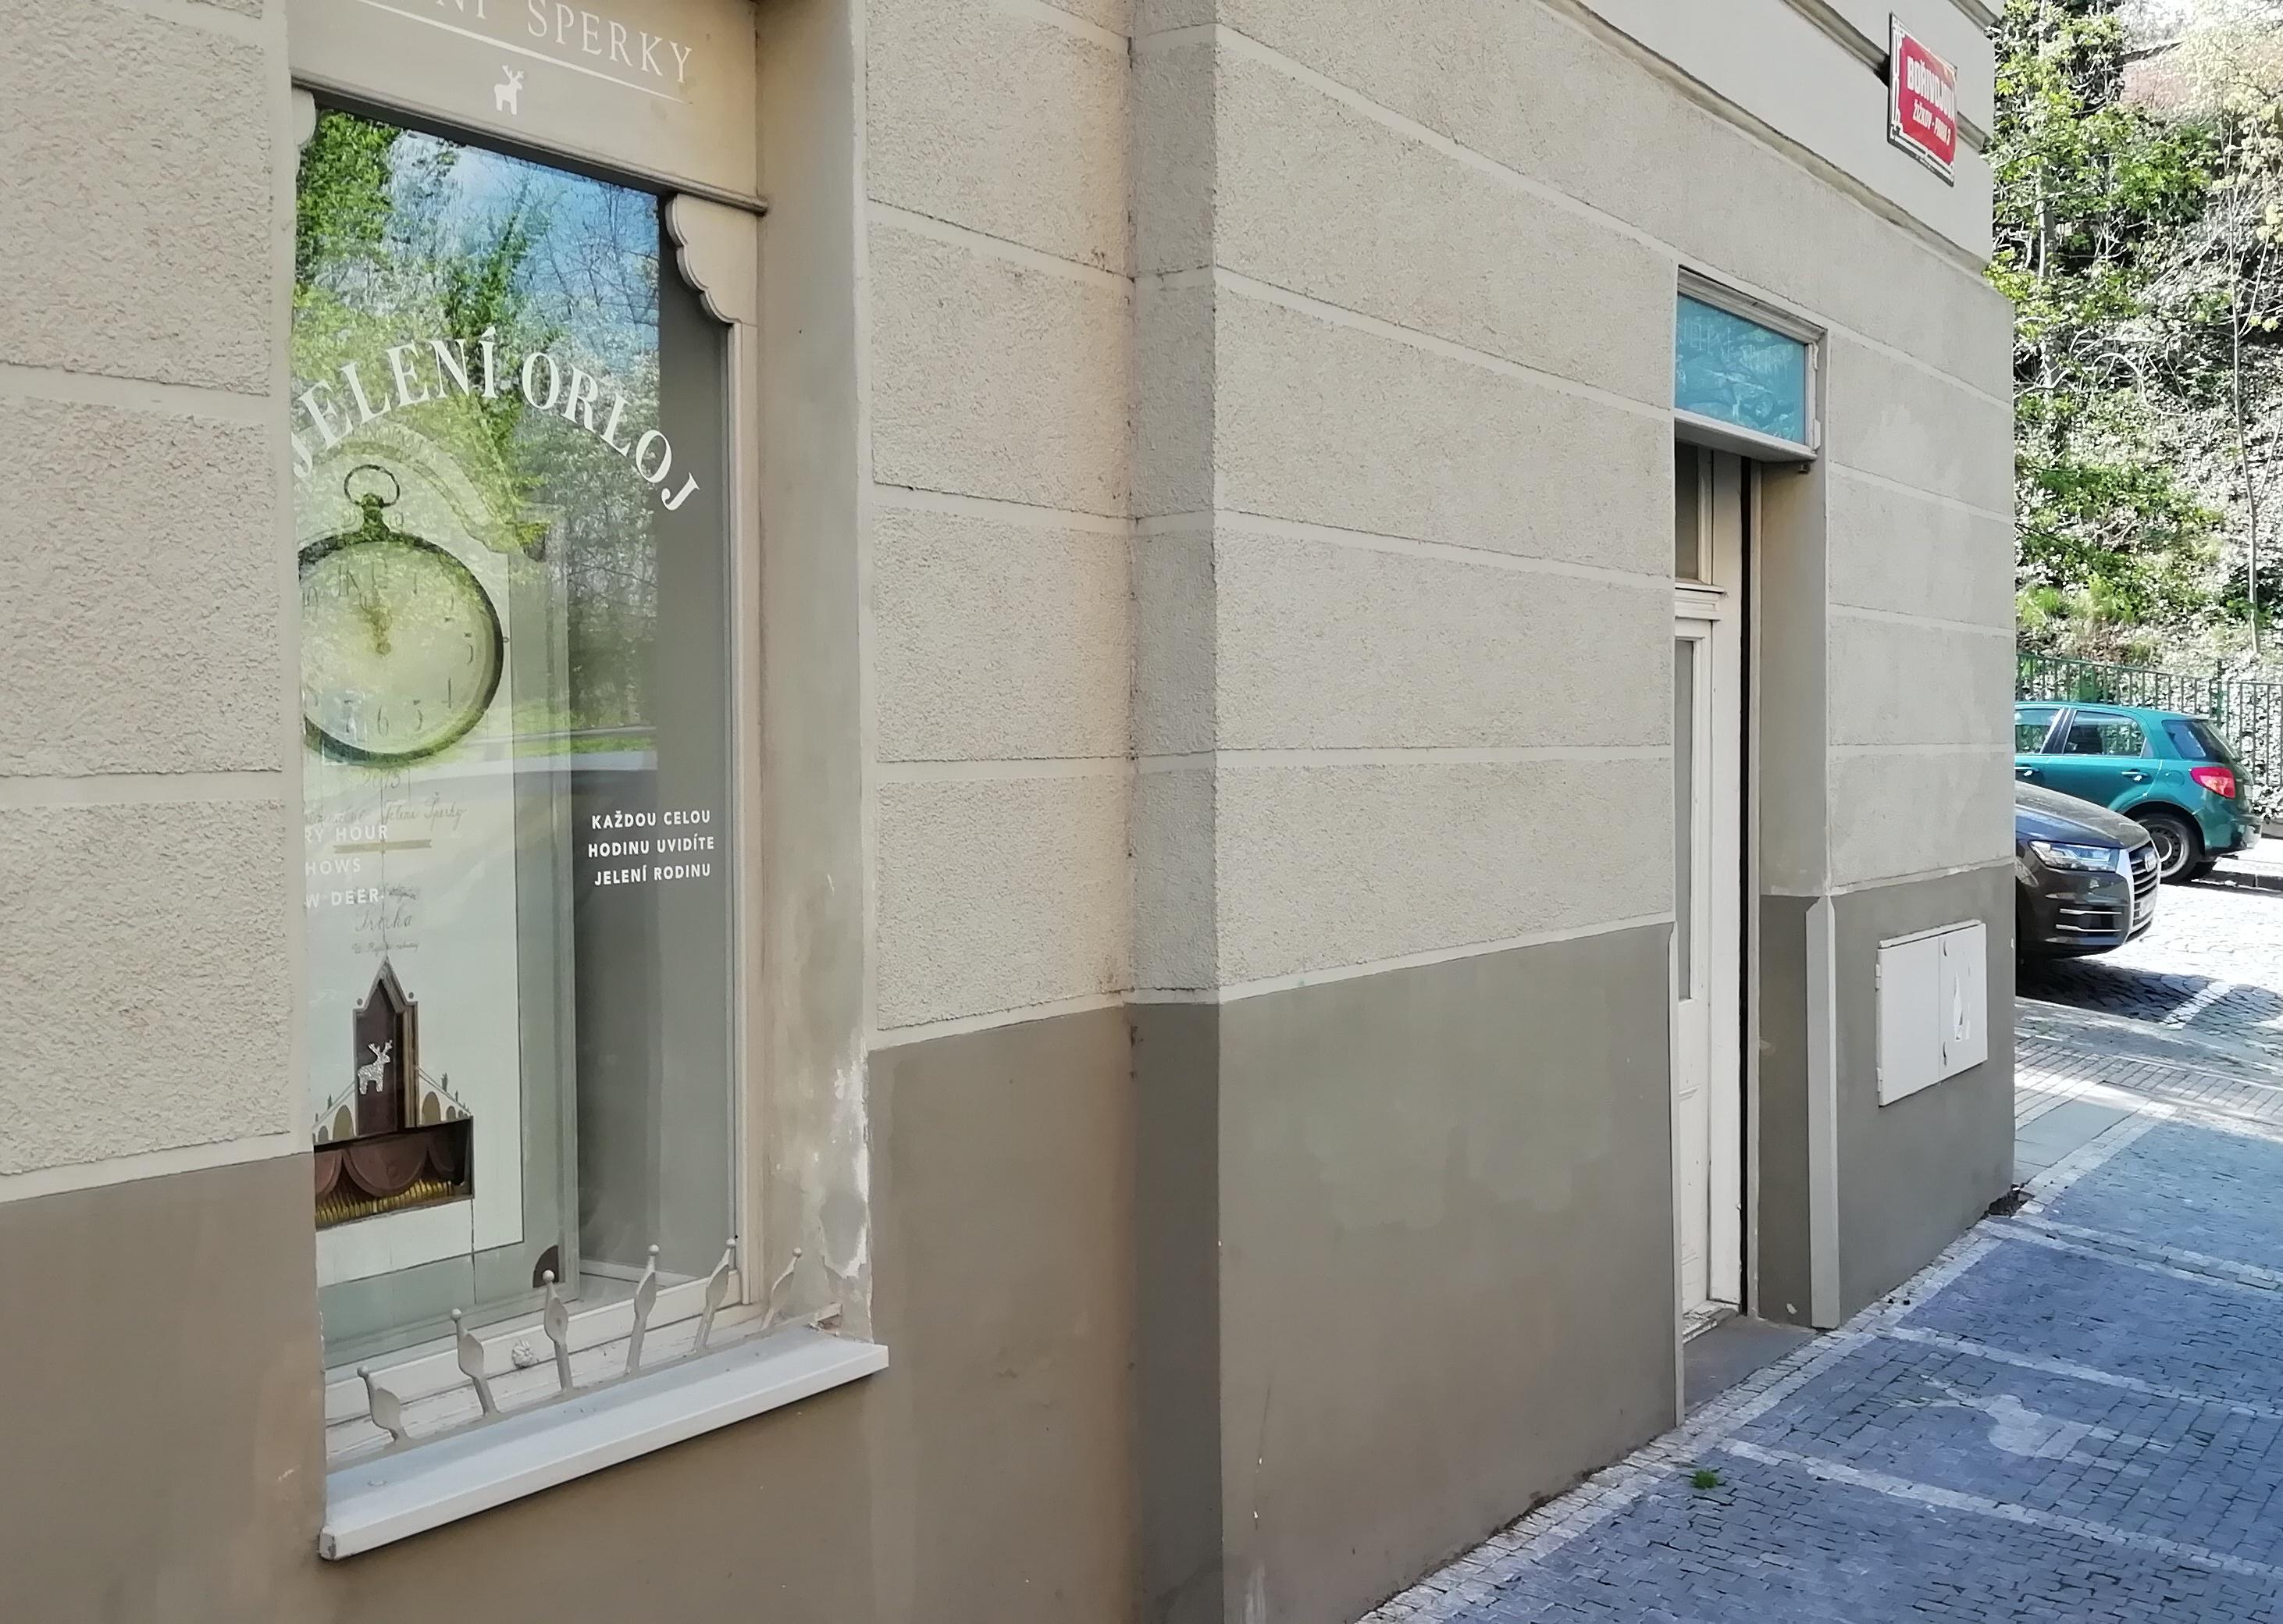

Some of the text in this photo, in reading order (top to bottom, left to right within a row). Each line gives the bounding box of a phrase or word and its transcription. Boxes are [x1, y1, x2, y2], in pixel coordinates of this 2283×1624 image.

[291, 326, 700, 511] JELENÍ ORLOJ
[592, 810, 711, 829] KAŽDOU CELOU
[336, 825, 388, 842] HOUR
[588, 833, 714, 858] HODINU UVIDÍTE
[594, 863, 711, 886] JELENÍ RODINU
